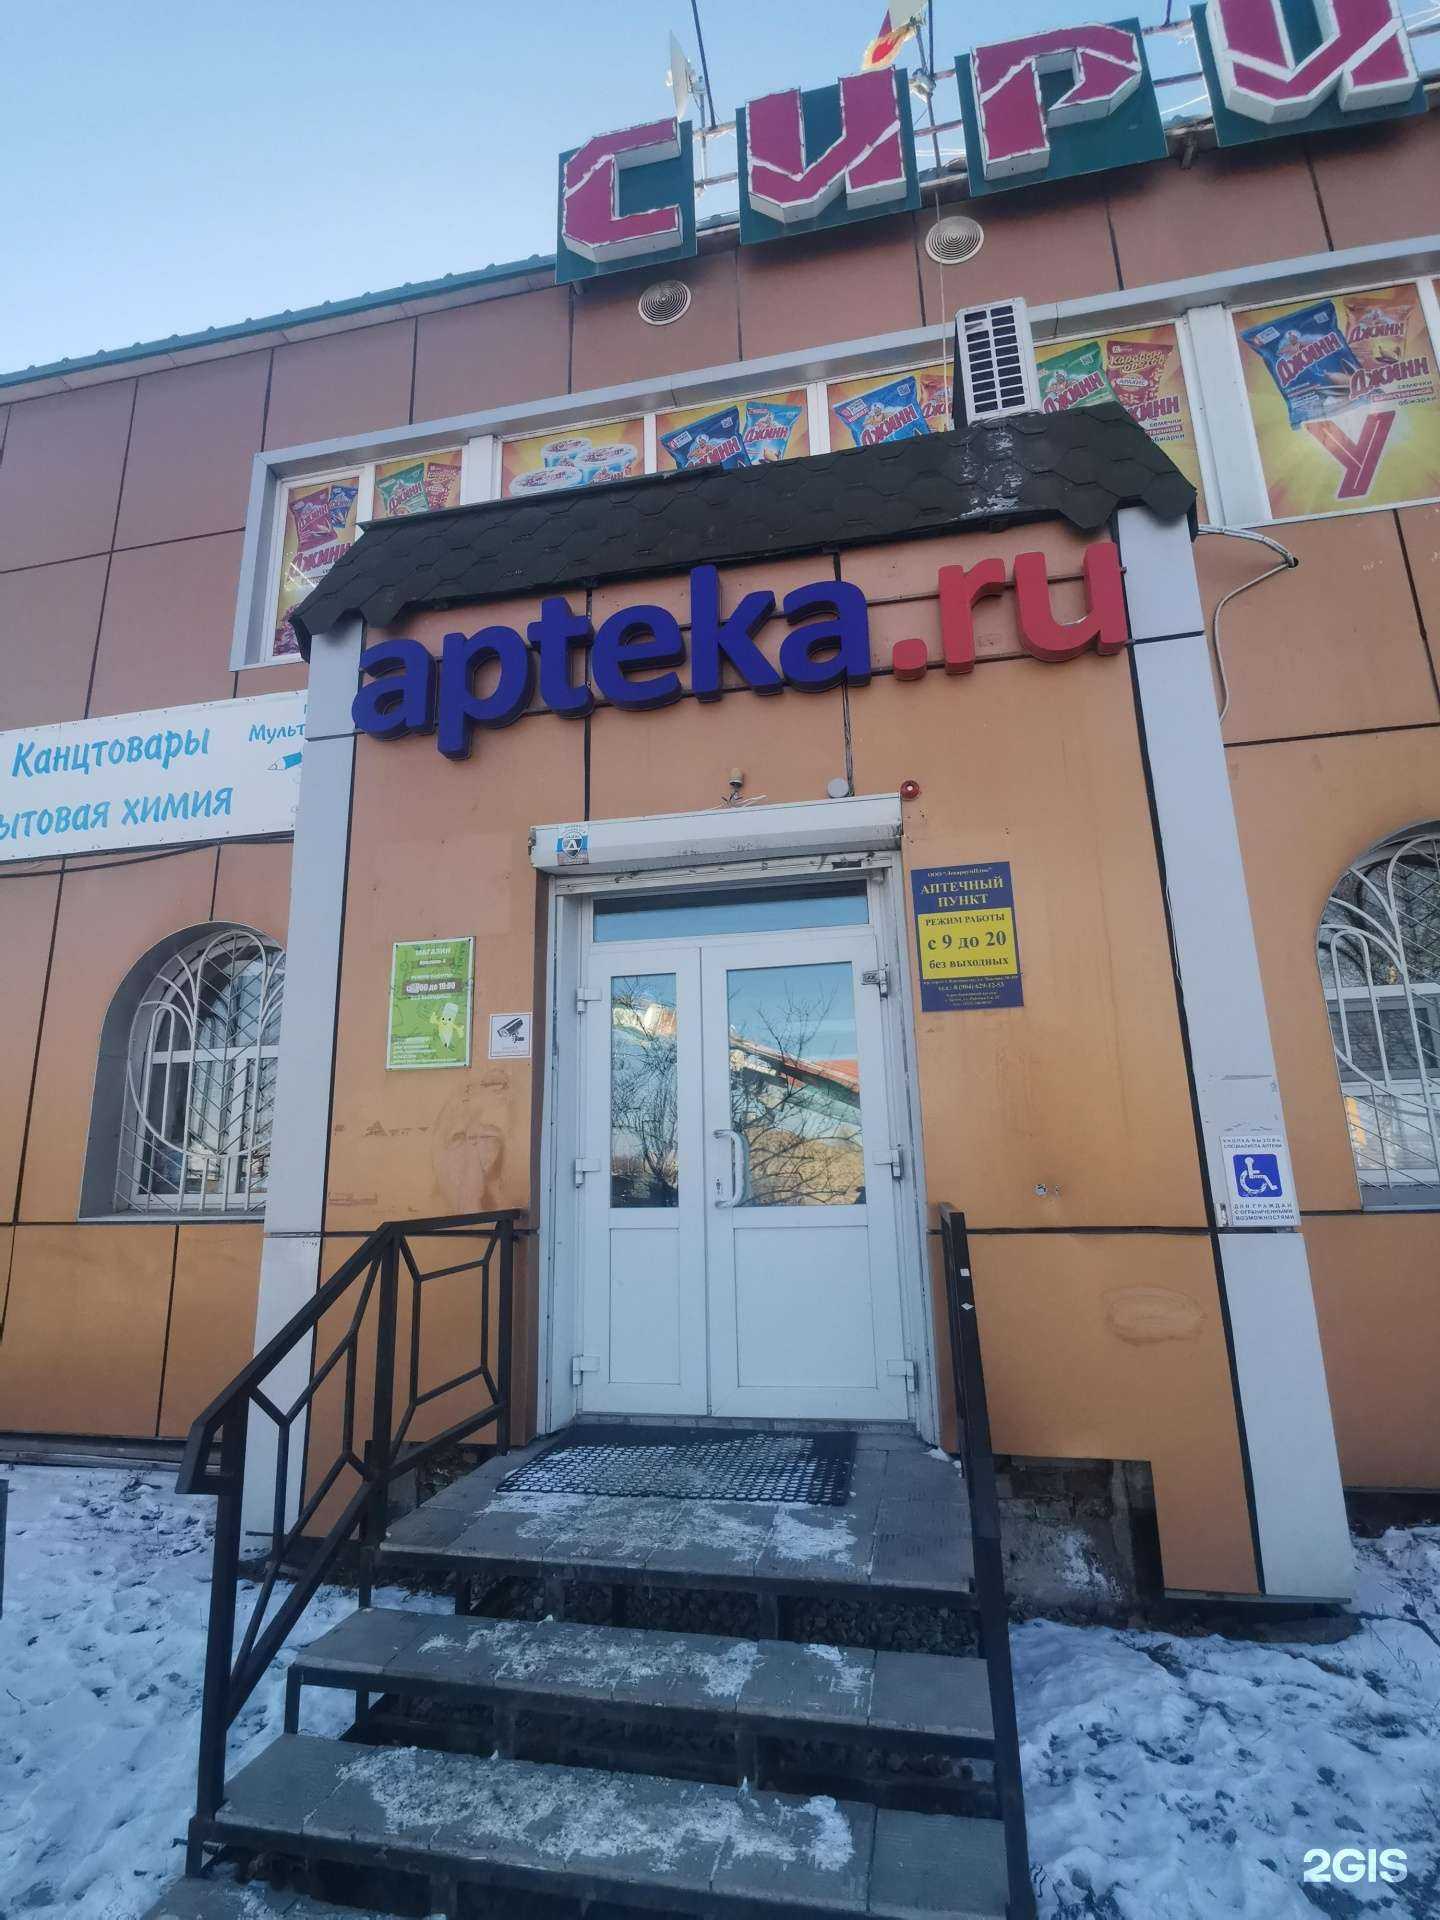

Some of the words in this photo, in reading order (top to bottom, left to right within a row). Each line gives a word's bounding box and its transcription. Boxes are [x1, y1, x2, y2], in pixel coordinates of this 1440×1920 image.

[351, 541, 1127, 761] apteka.ru
[11, 728, 210, 778] Канцтовары
[121, 787, 234, 826] химия
[921, 875, 1004, 895] АПТЕЧНЫЙ
[937, 893, 989, 908] ПУНКТ
[925, 915, 962, 927] РЕЖИМ
[965, 913, 1005, 925] РАБОТЫ
[927, 938, 936, 950] с
[942, 934, 952, 949] 9
[958, 936, 980, 950] до
[985, 930, 1007, 947] 20
[929, 960, 946, 970] без
[950, 956, 1009, 968] выходных
